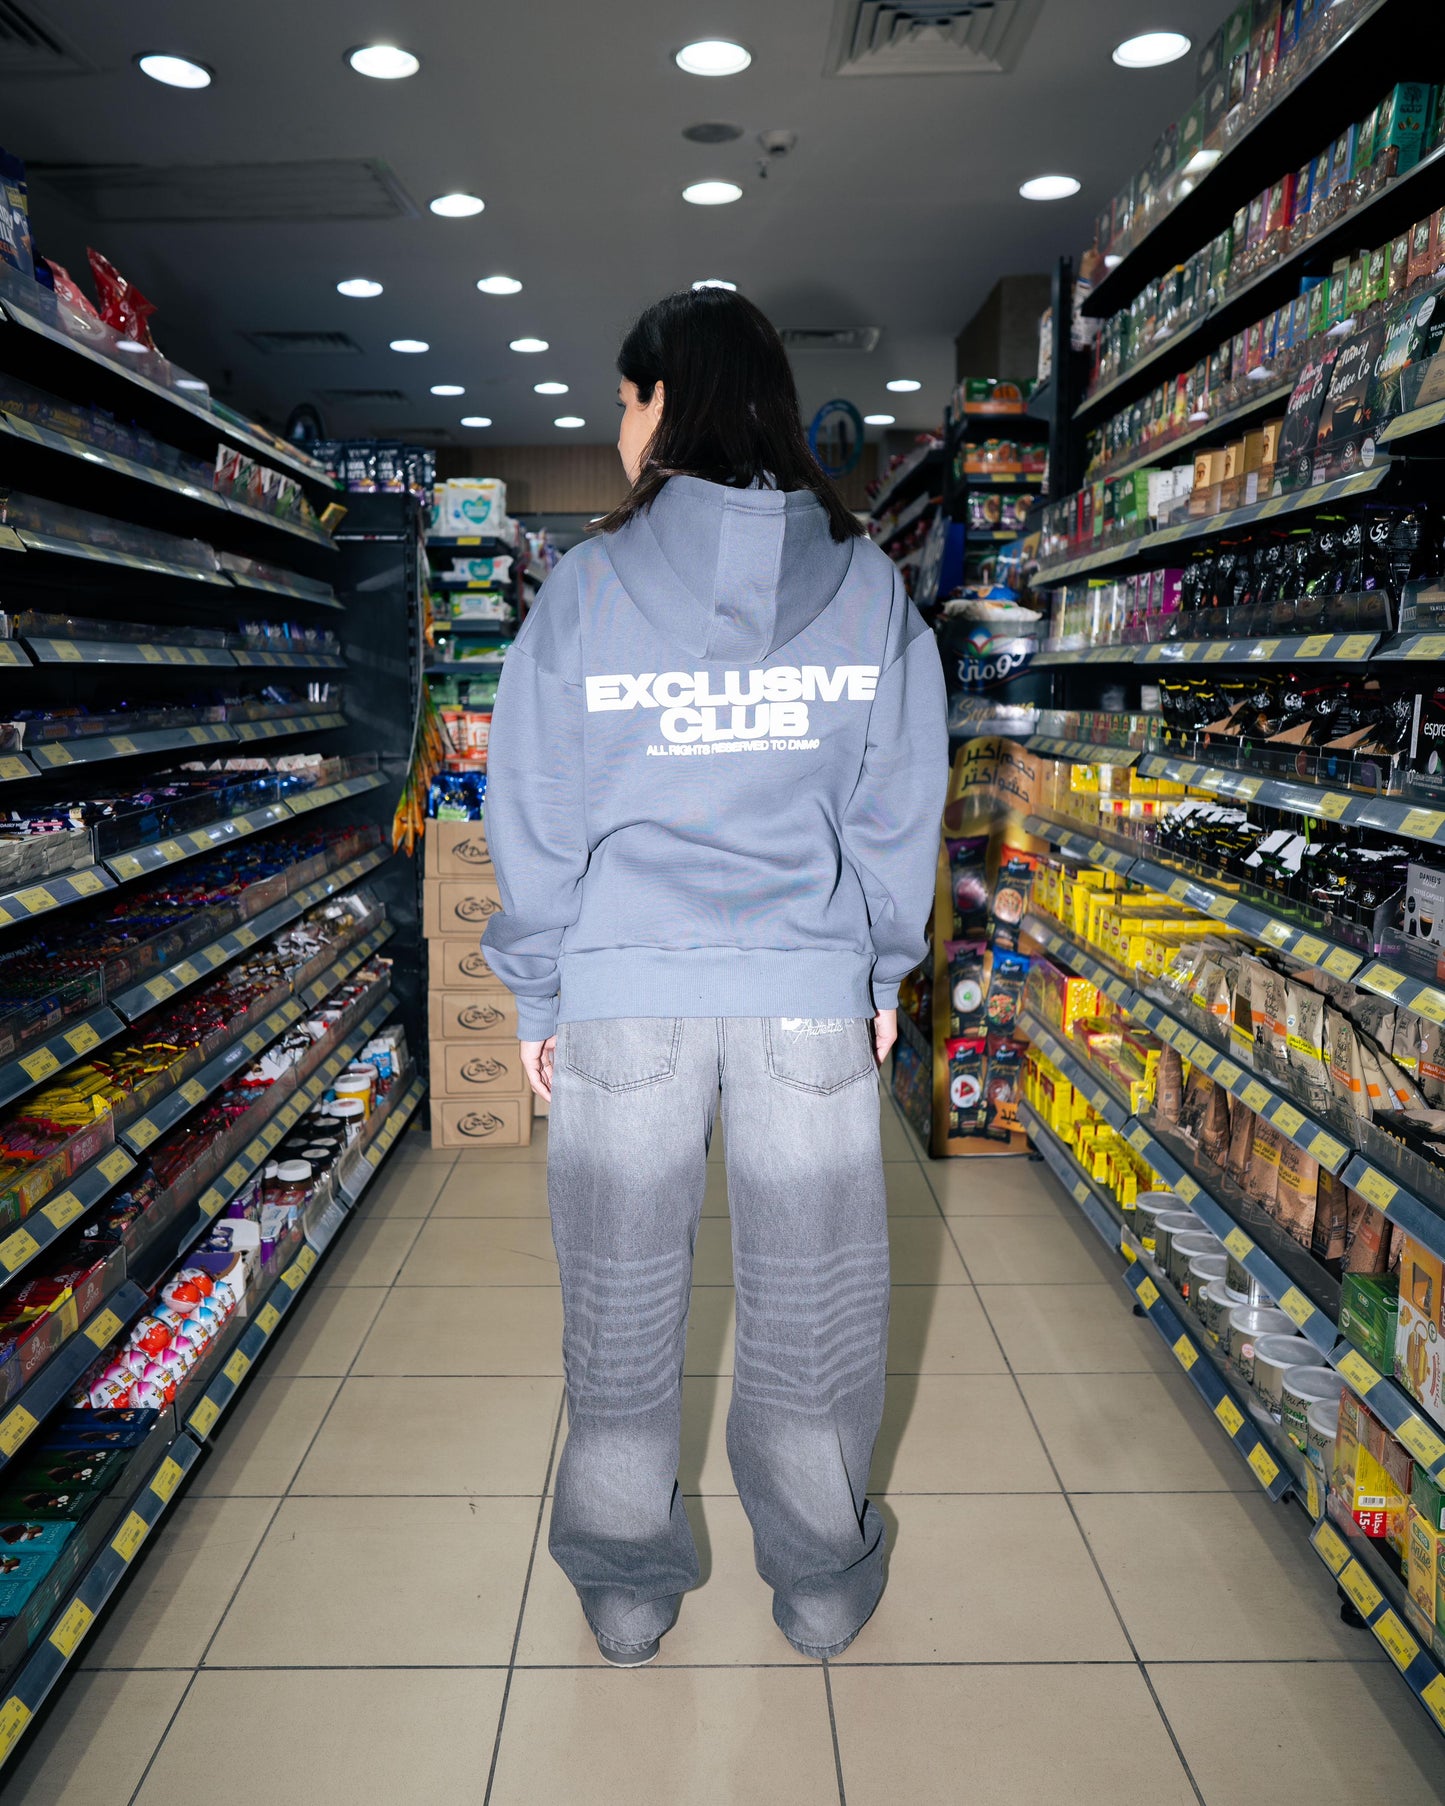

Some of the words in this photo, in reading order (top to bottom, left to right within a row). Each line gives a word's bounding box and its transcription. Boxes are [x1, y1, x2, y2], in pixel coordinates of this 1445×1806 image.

[585, 665, 880, 712] EXCLUSIVE
[660, 701, 809, 744] CLUB
[646, 744, 669, 756] ALL
[669, 743, 711, 756] RIGHTS
[711, 740, 769, 755] RESERVED
[771, 739, 787, 751] TO
